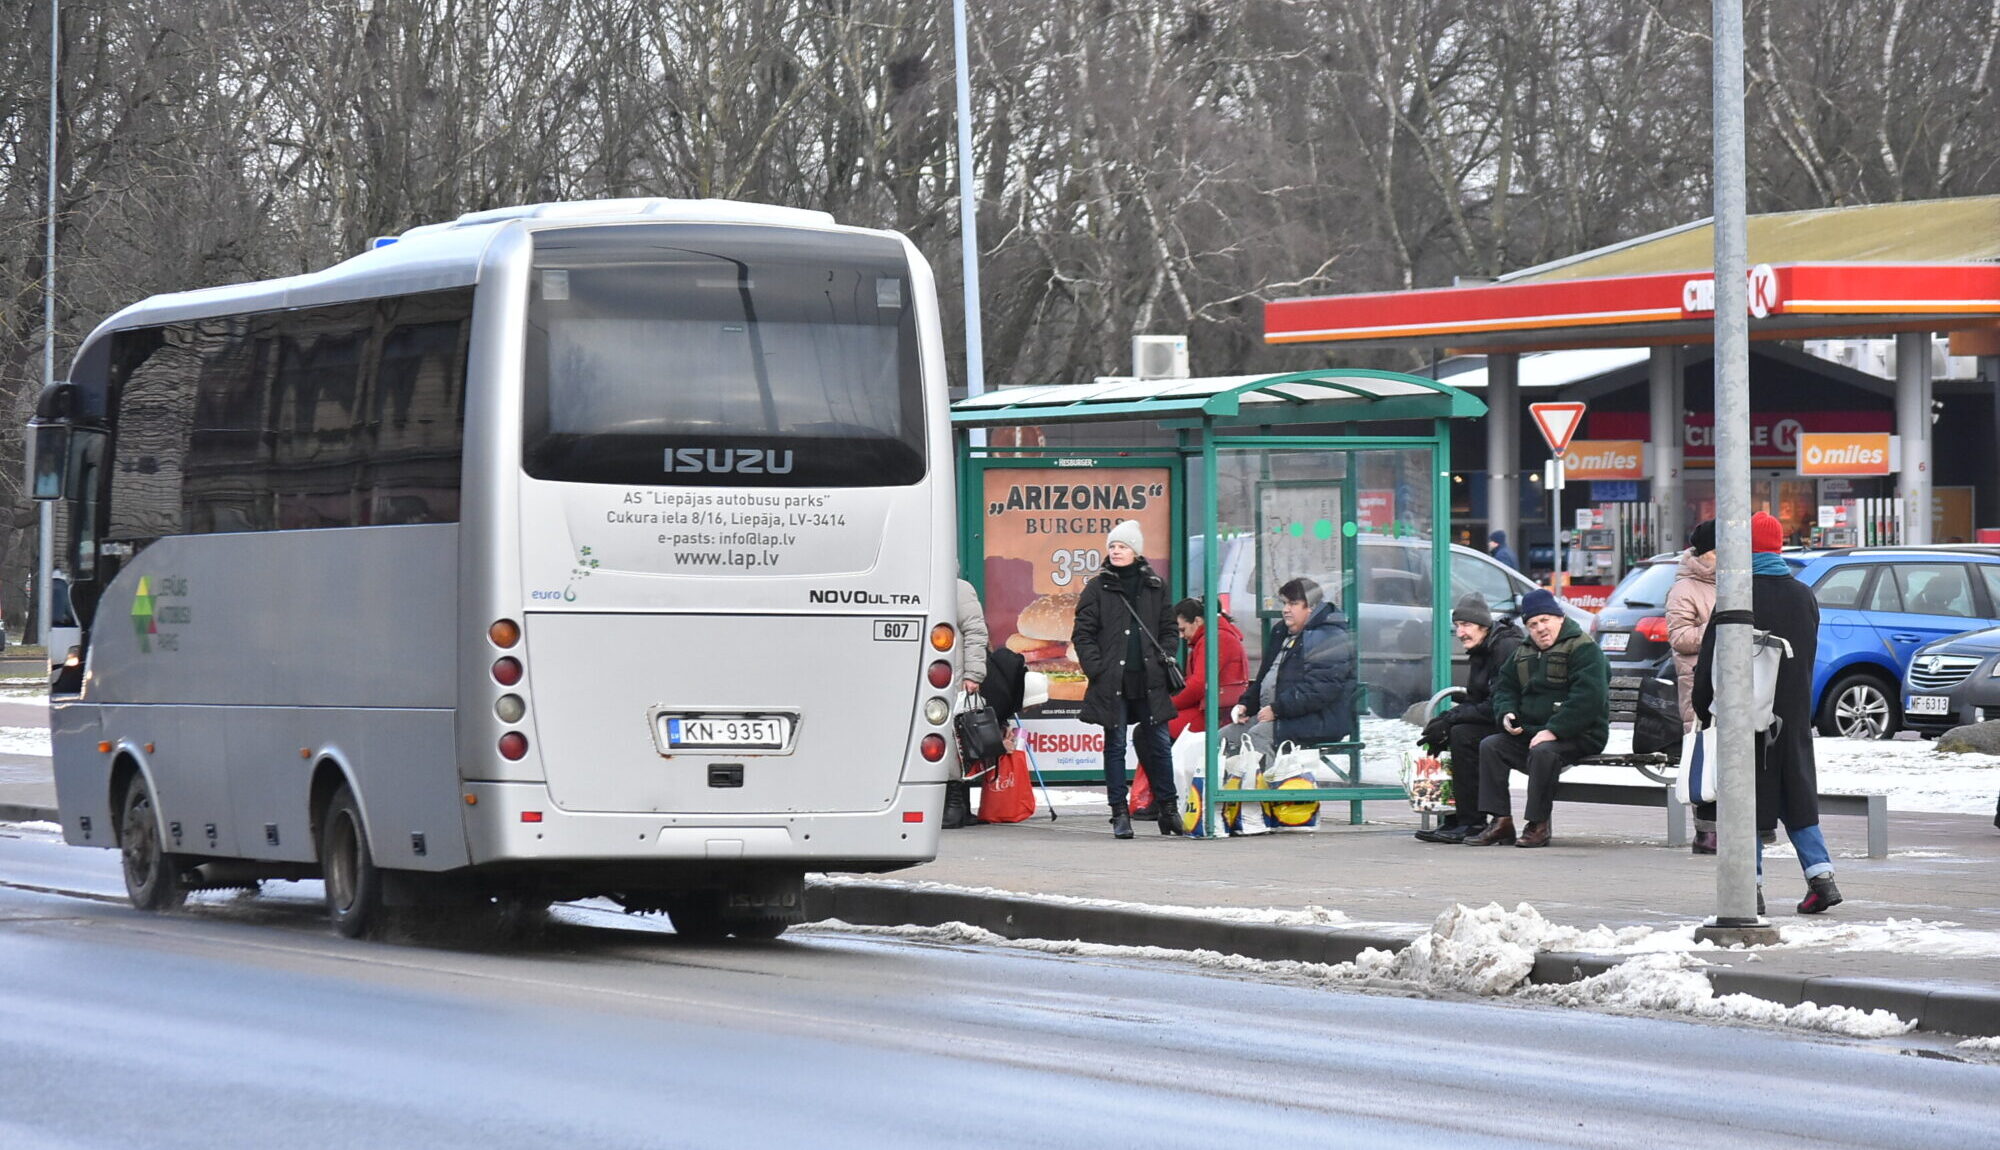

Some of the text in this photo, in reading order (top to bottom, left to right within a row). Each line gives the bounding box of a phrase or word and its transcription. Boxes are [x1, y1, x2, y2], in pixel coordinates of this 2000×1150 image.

[664, 448, 793, 474] ISUZU
[1581, 451, 1638, 470] miles
[1824, 445, 1883, 465] miles
[1671, 469, 1678, 478] 2
[1918, 462, 1926, 472] 6
[623, 492, 642, 504] AS
[716, 494, 780, 506] autobusu
[606, 511, 846, 528] Cukura iela 8/16, Liepāja, LV-3414
[657, 532, 796, 548] e-pasts: info@lap.lv
[674, 550, 779, 569] www.lap.lv
[531, 589, 561, 600] euro
[1570, 594, 1606, 608] miles
[884, 623, 910, 638] 607
[685, 722, 777, 741] KN-9351
[1026, 732, 1105, 754] HESBURG
